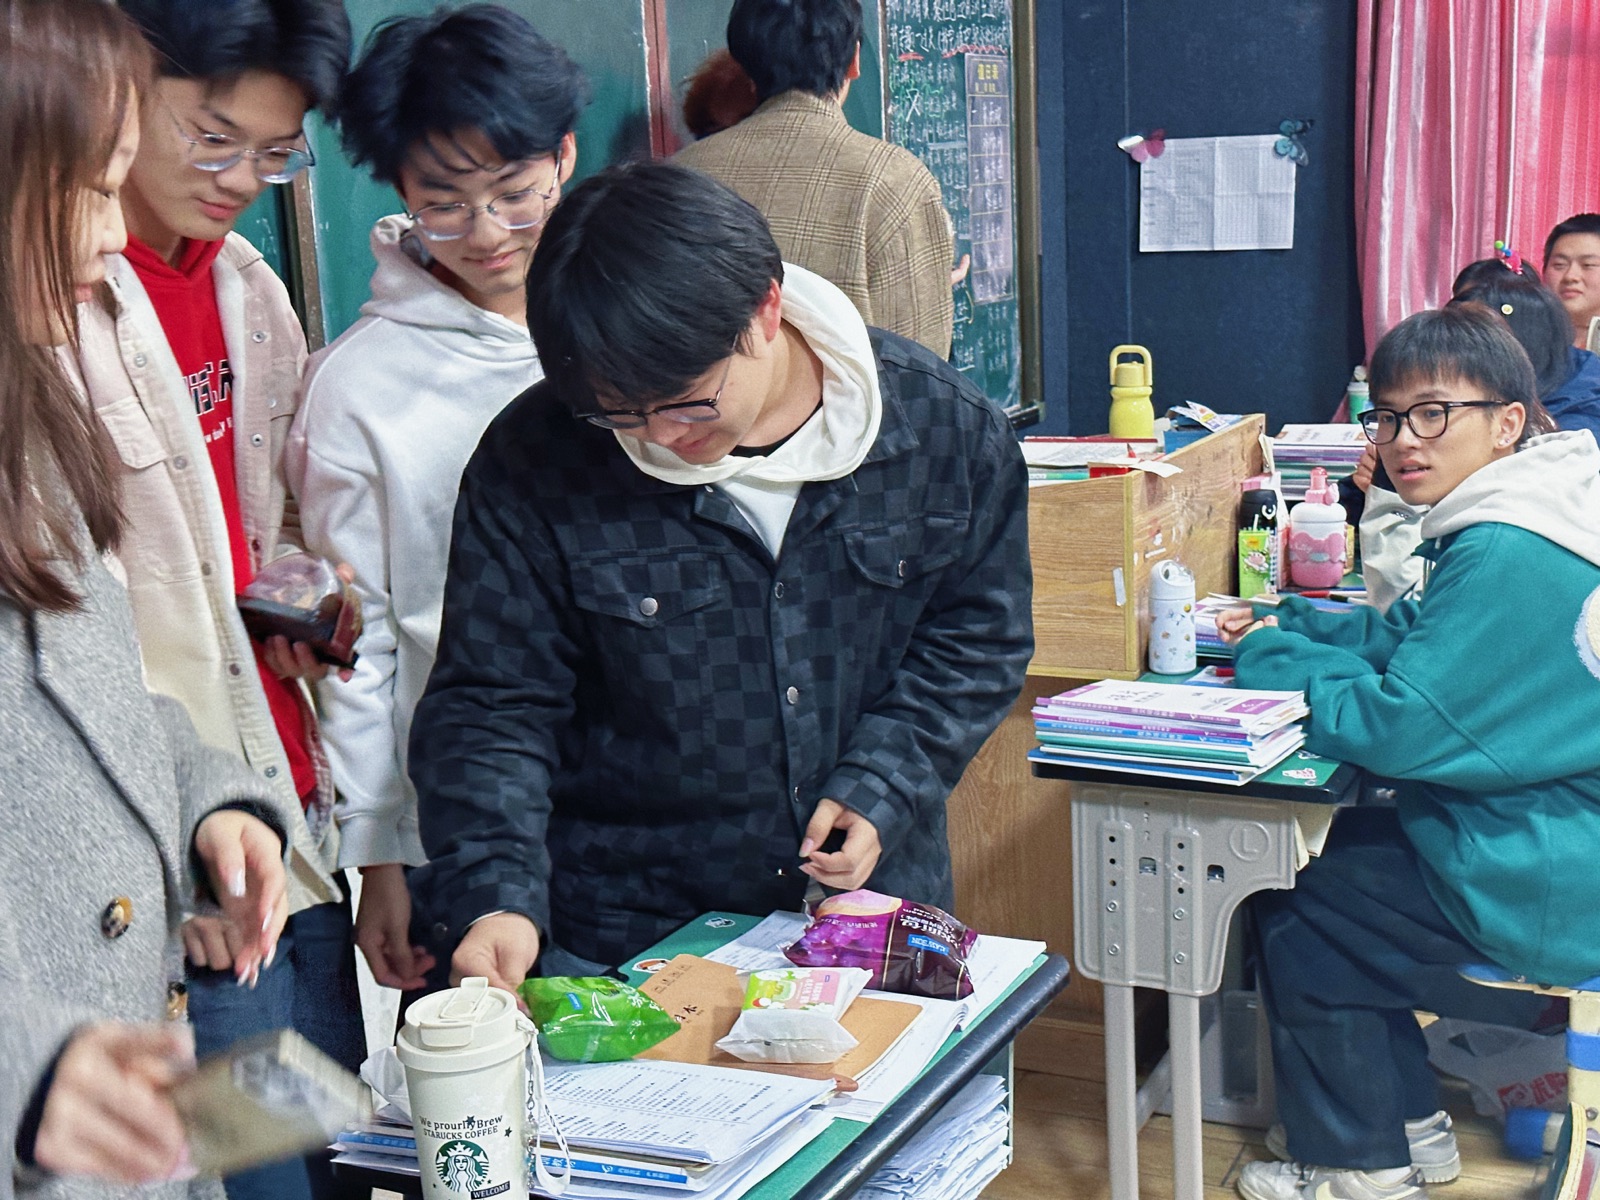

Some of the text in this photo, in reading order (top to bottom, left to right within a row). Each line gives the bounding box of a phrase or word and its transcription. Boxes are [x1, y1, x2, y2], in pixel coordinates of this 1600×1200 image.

[419, 1115, 432, 1128] We
[477, 1115, 503, 1129] Brew
[423, 1125, 499, 1140] STARUCKS COFFEE
[472, 1182, 509, 1198] WELCOME
